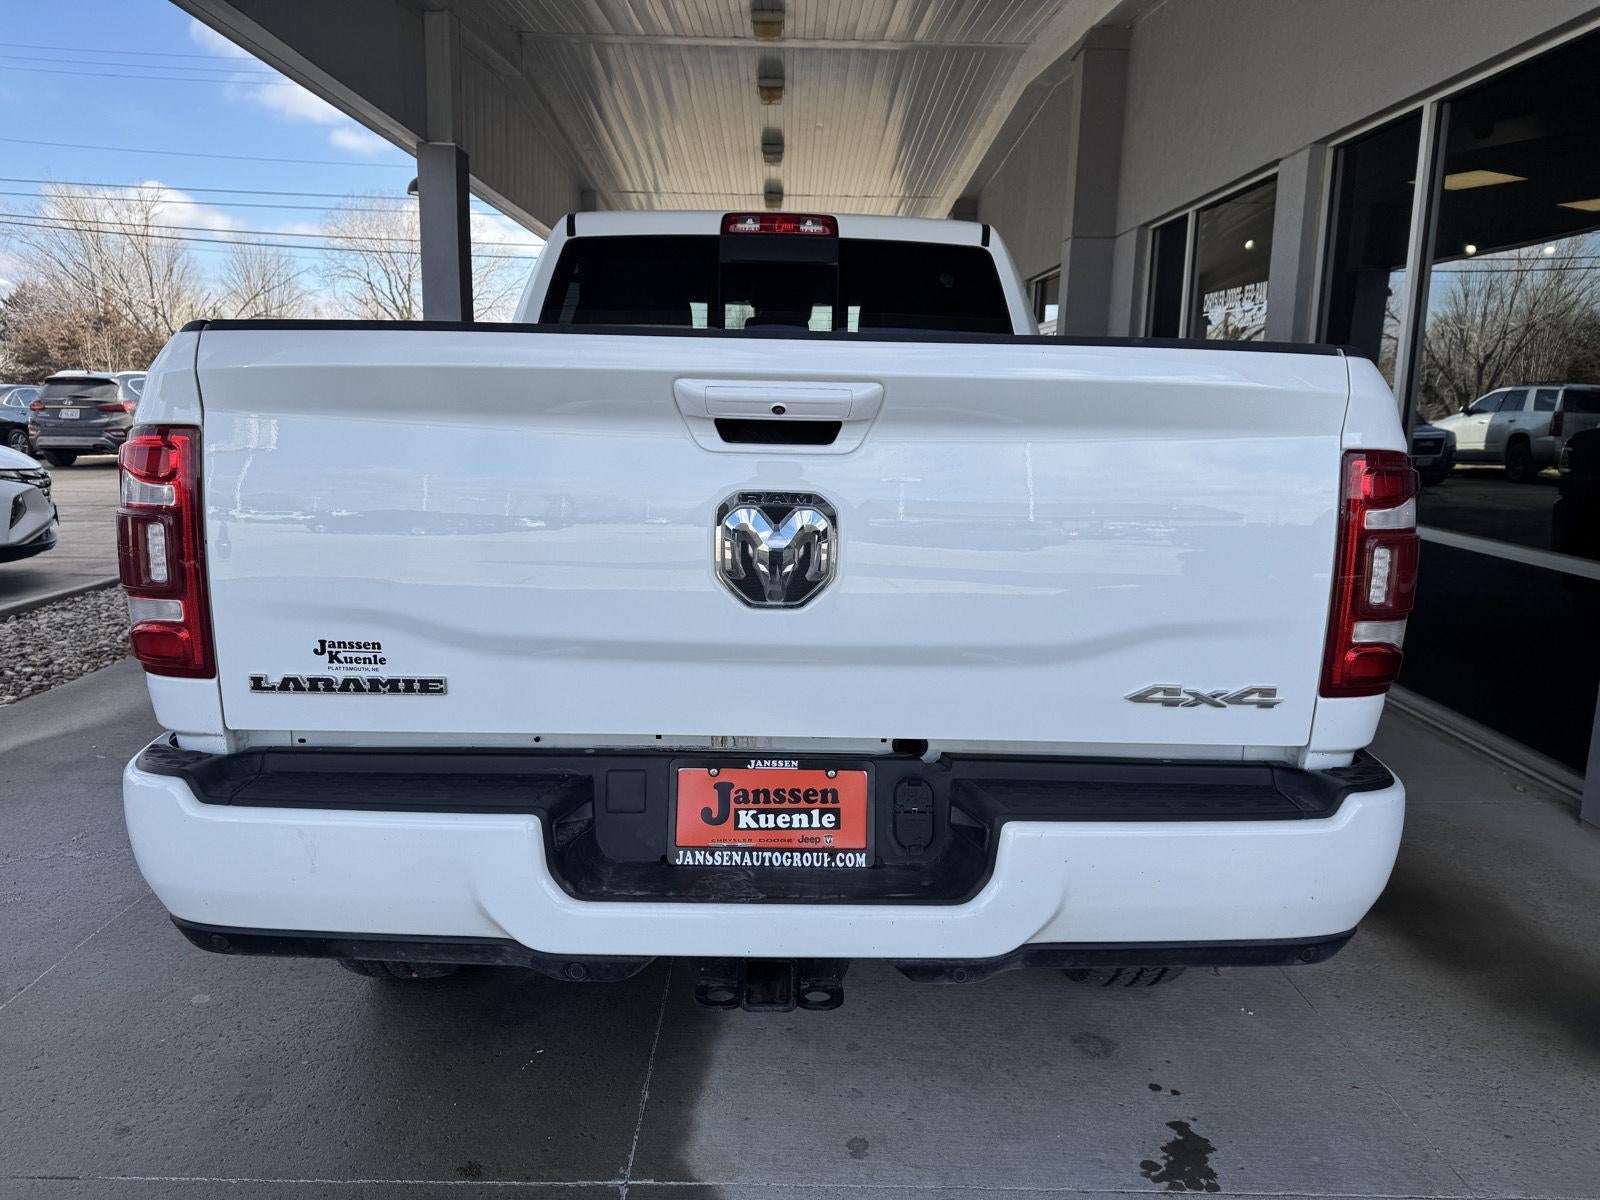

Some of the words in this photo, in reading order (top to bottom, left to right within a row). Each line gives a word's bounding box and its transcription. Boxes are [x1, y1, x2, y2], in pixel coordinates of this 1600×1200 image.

[740, 493, 813, 504] RAM
[312, 639, 382, 656] Janssen
[327, 650, 387, 665] Kuenle
[327, 665, 371, 673] PLATTSMOUTH,
[248, 674, 447, 695] LARAMIE
[747, 759, 799, 770] JANSSEN
[700, 781, 841, 827] Janssen
[737, 808, 836, 830] Kuenle
[797, 834, 821, 845] Jeep
